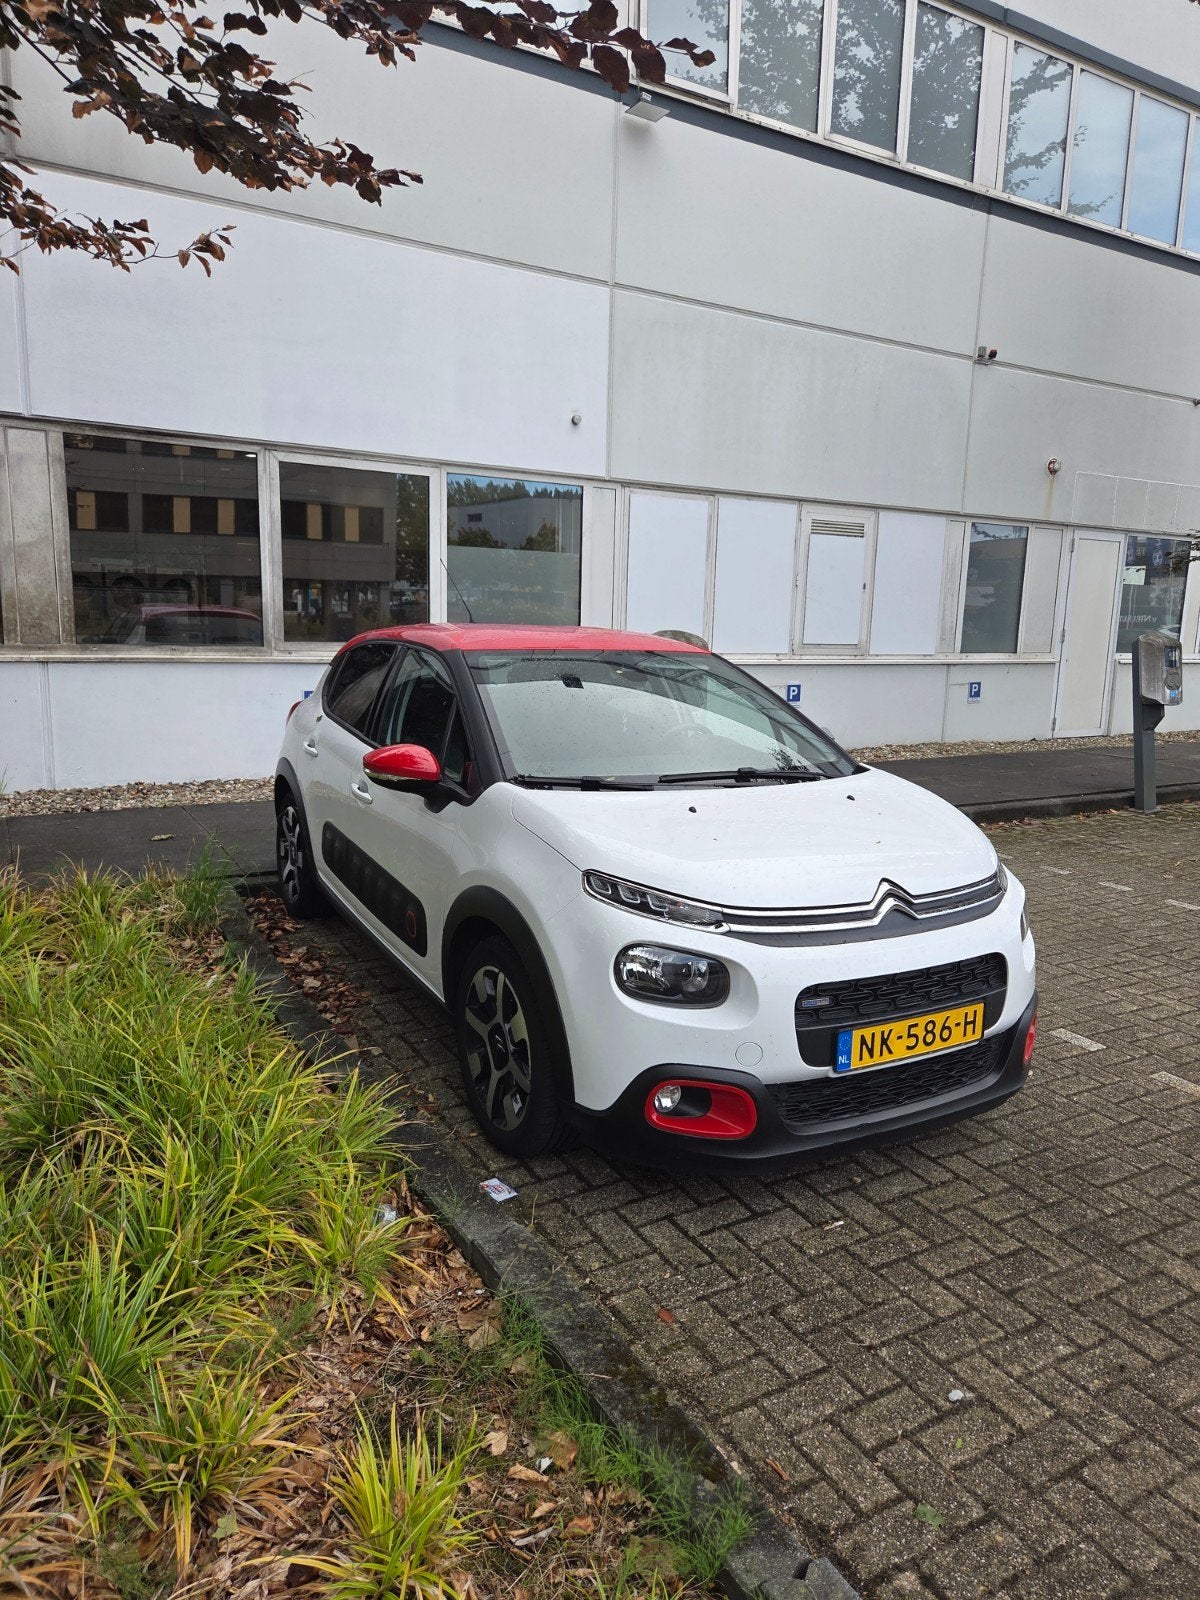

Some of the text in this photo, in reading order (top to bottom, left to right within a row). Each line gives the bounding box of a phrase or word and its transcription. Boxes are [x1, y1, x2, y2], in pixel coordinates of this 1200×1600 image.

[789, 686, 798, 700] P
[971, 684, 979, 696] P
[858, 1009, 978, 1062] NK-586-H
[838, 1054, 850, 1065] NL
